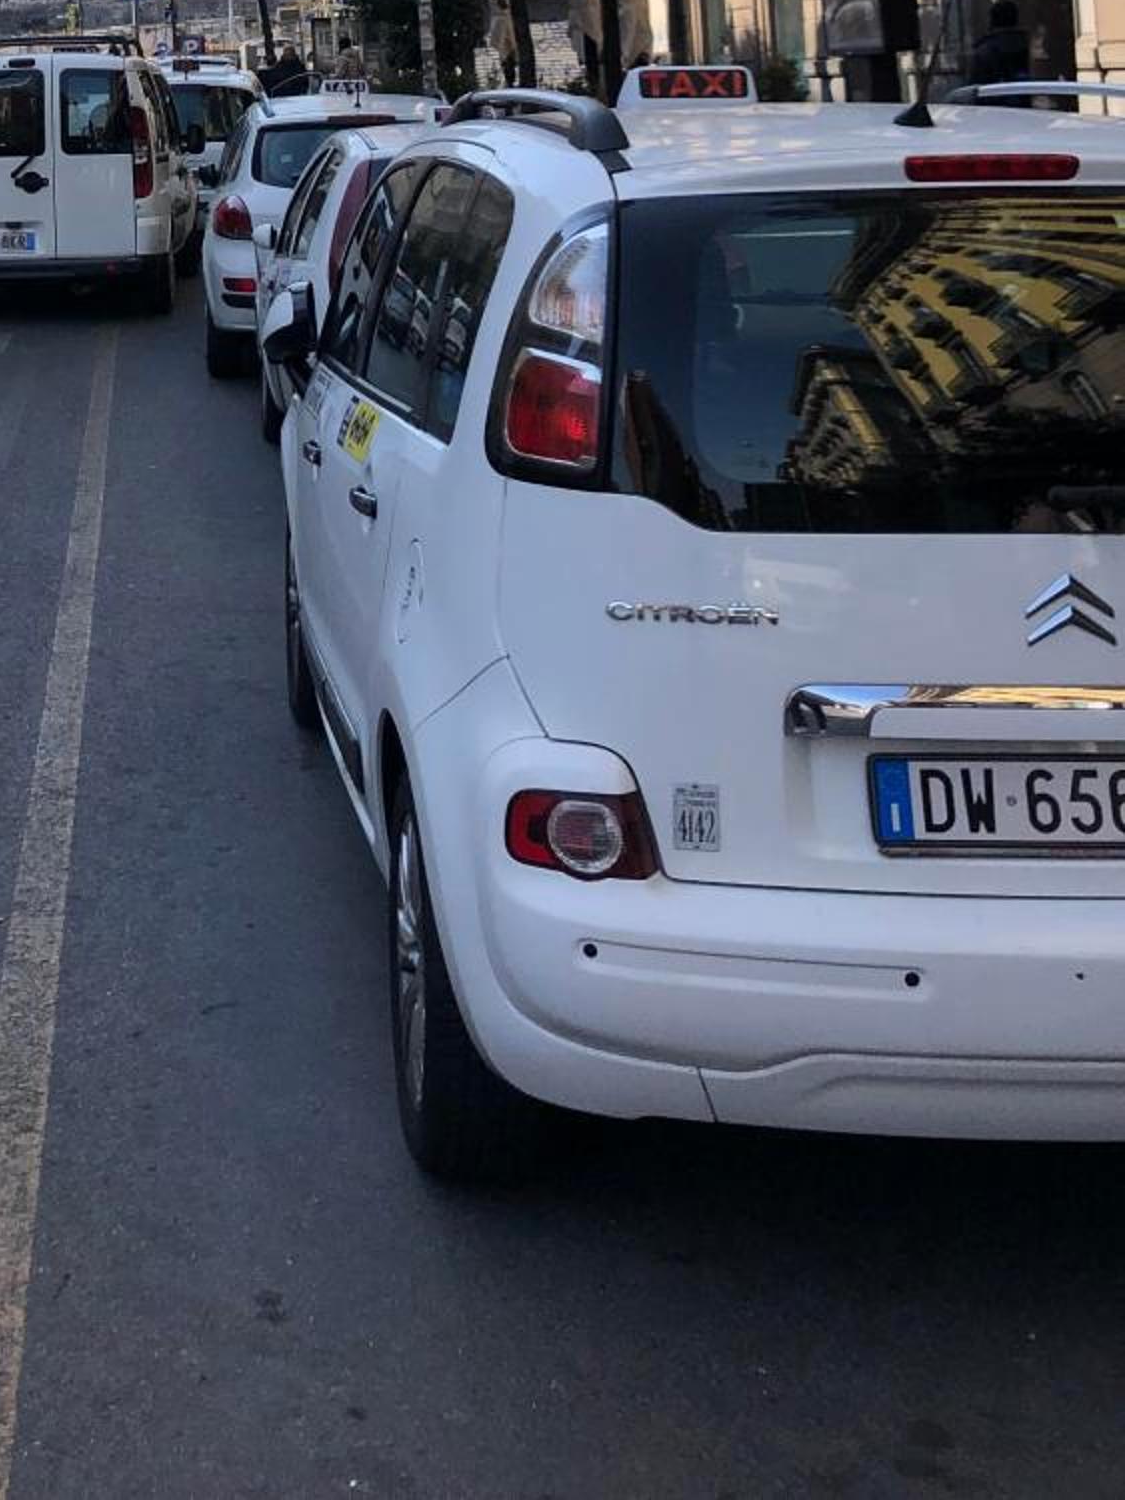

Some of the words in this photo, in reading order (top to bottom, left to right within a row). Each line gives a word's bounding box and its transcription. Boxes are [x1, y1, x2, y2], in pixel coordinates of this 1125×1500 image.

[641, 70, 744, 97] TAXI
[919, 767, 997, 834] DW
[677, 808, 716, 843] 4142
